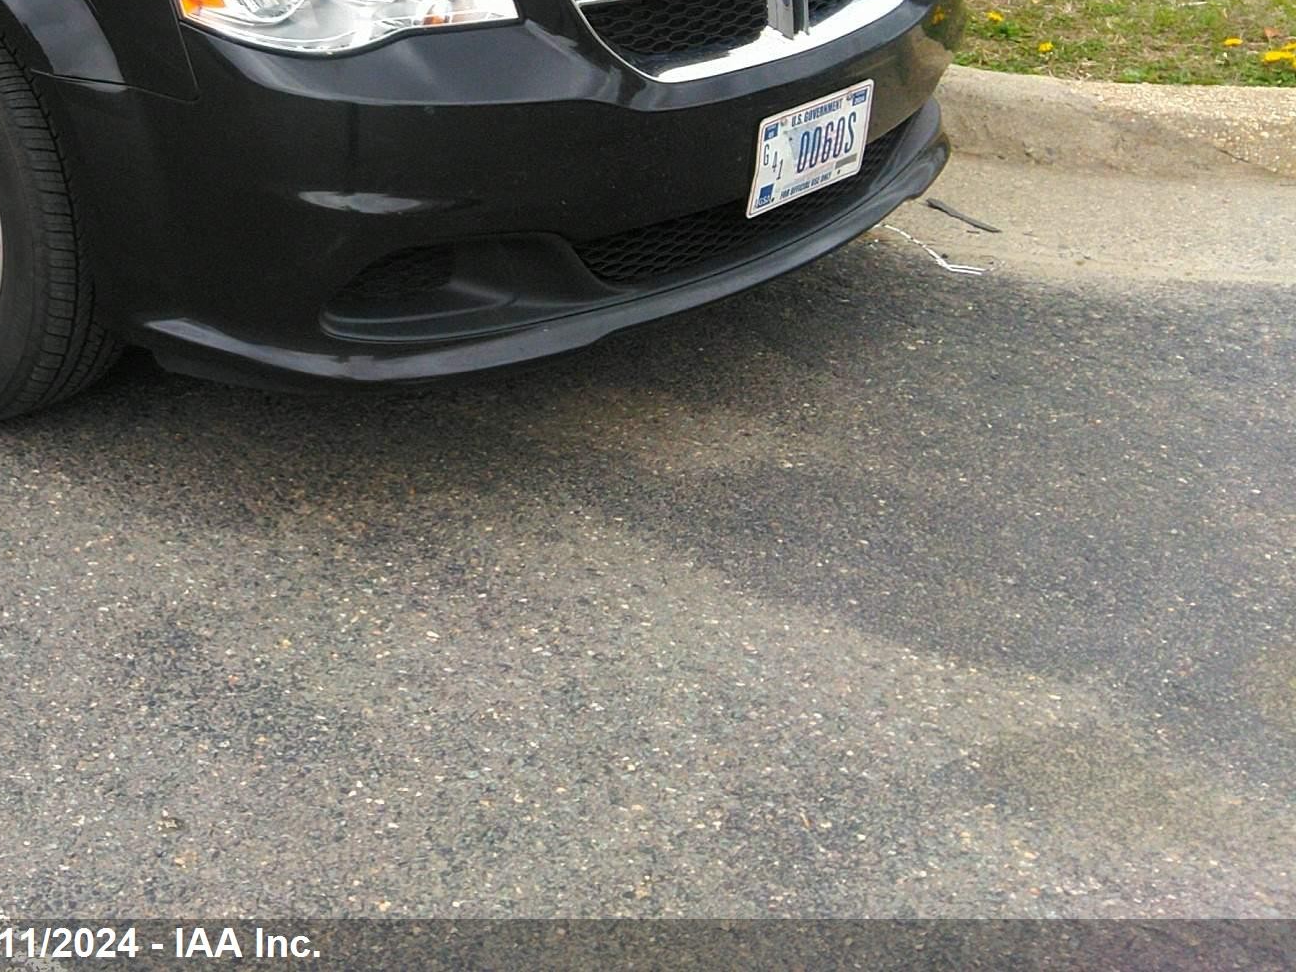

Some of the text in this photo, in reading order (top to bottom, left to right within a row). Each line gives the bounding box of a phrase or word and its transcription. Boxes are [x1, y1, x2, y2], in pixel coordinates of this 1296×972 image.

[791, 98, 843, 127] U.S. GOVERNMENT
[797, 111, 857, 174] 0060S
